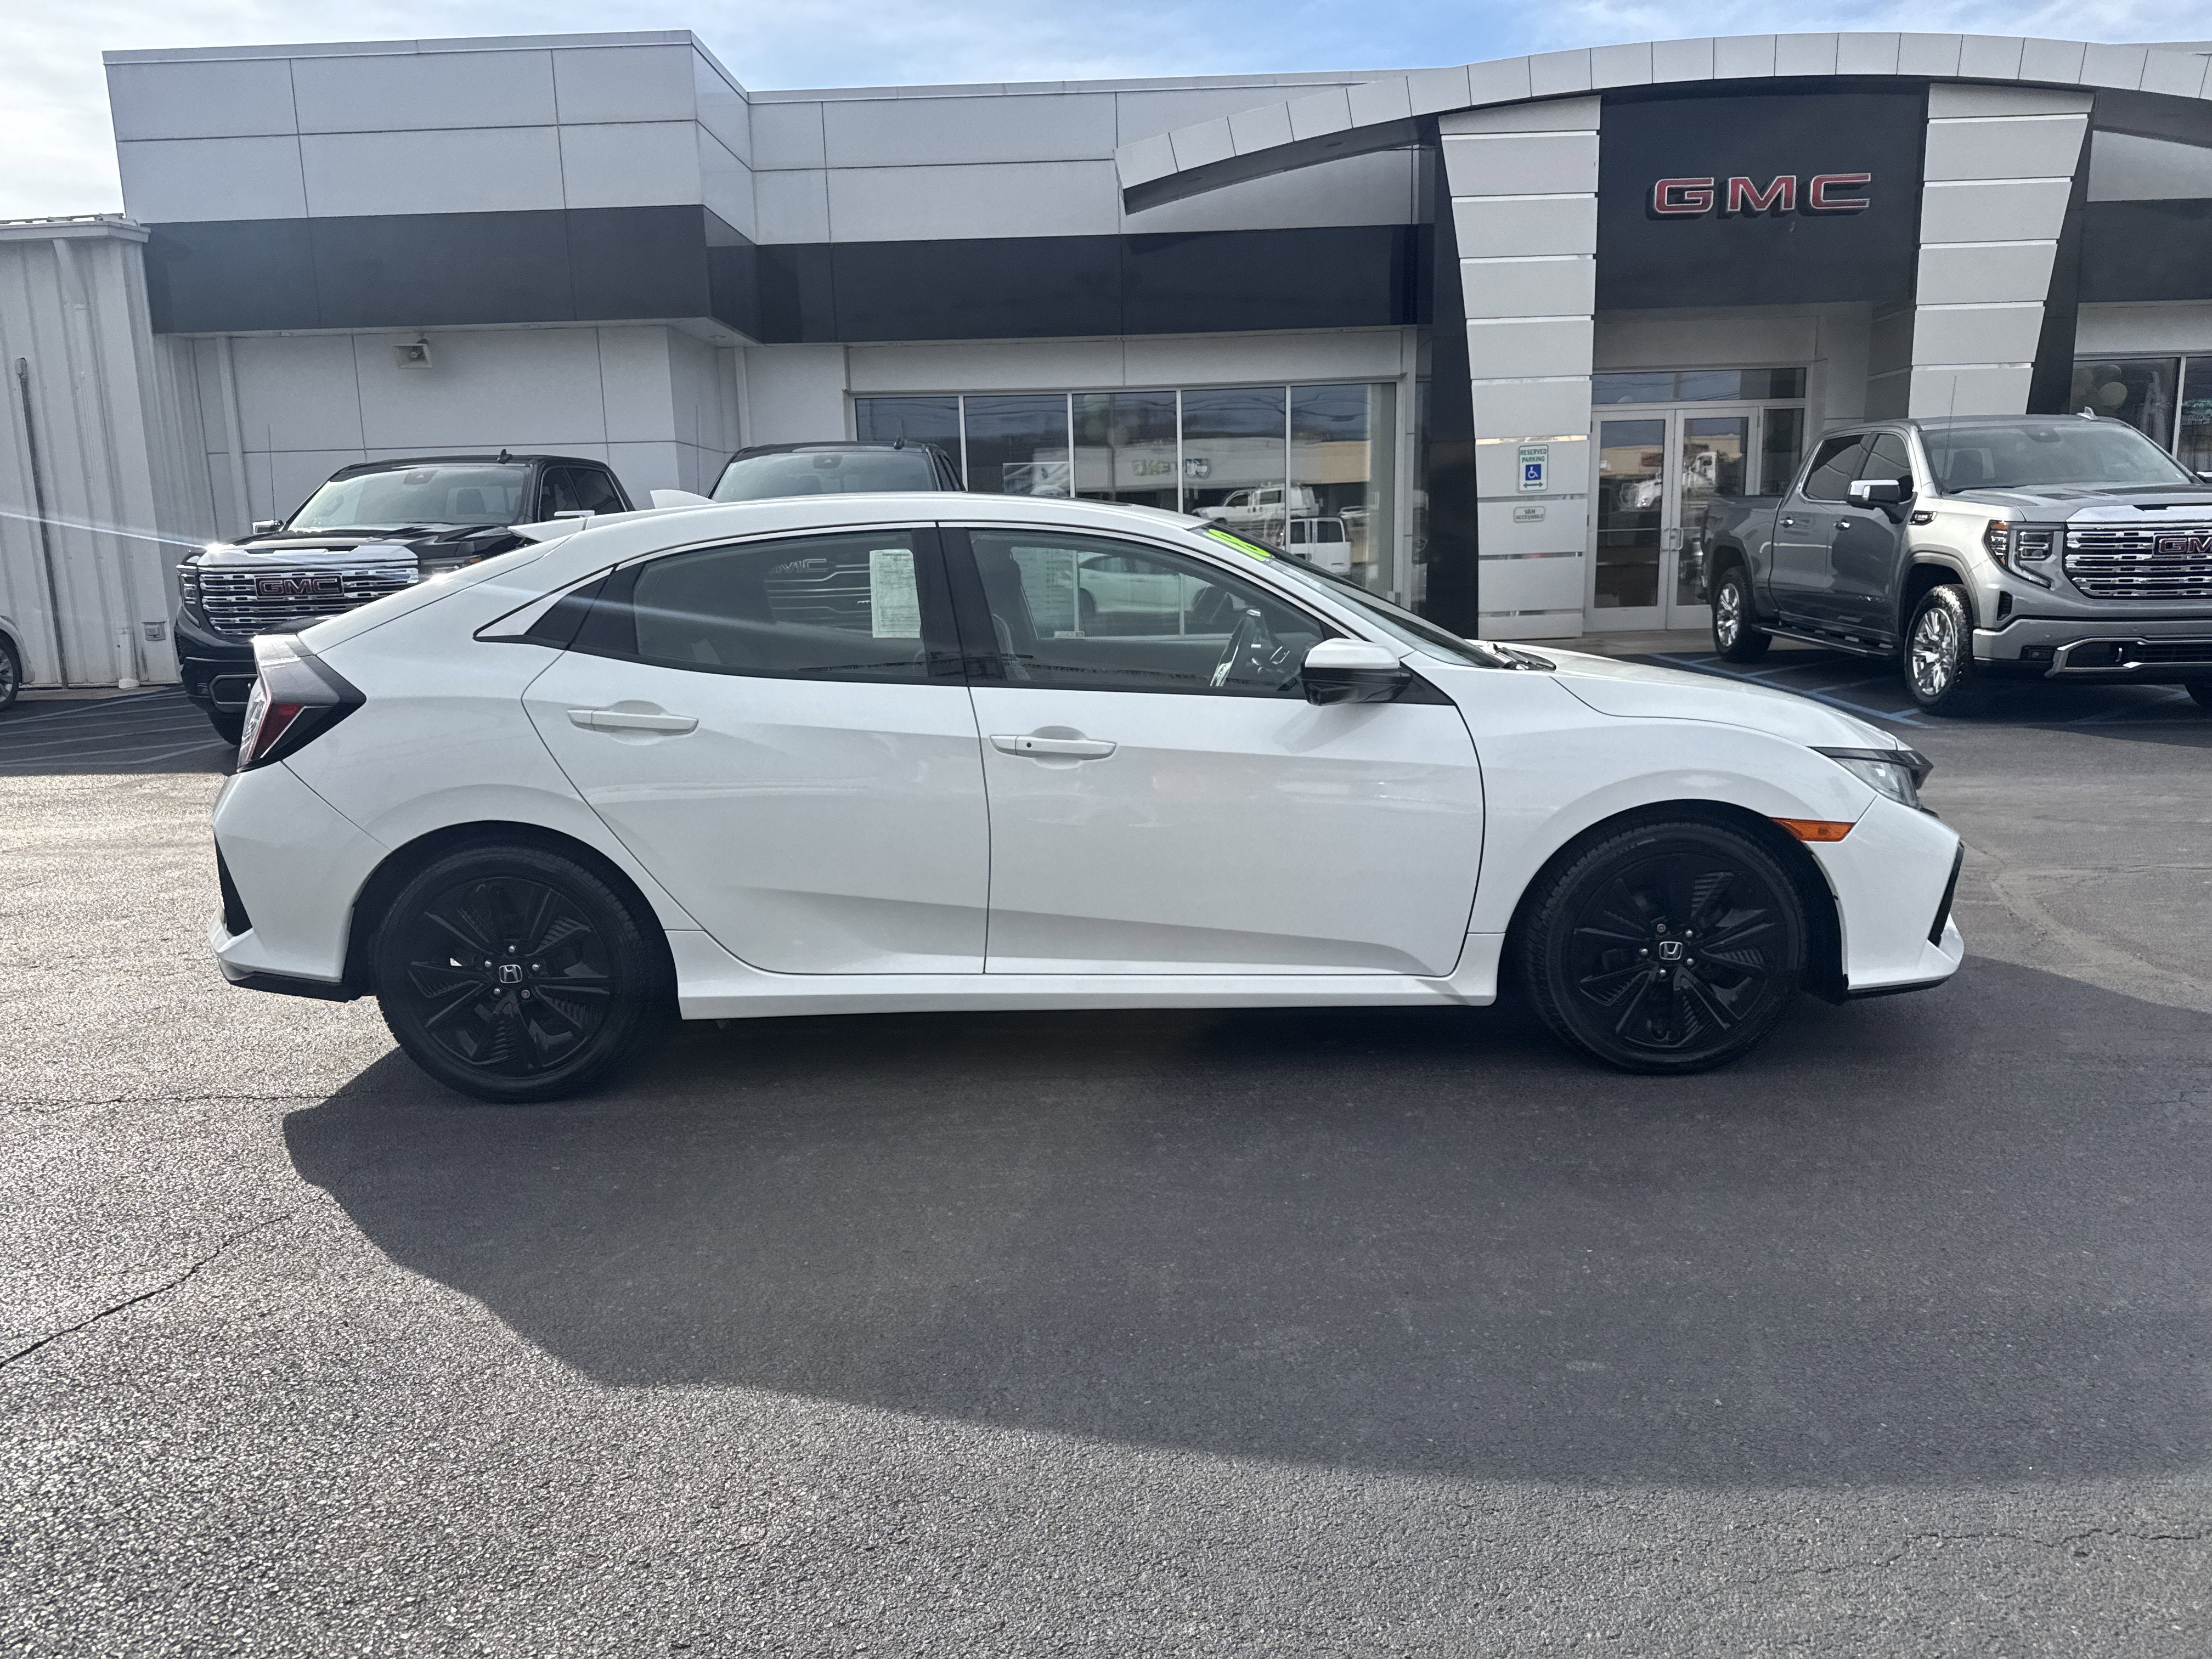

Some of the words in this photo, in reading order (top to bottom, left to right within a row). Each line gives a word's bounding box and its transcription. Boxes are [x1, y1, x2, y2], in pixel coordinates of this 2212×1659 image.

[1655, 172, 1871, 213] GMC
[2159, 537, 2212, 554] GM
[770, 558, 829, 573] MC
[259, 578, 340, 595] GMC
